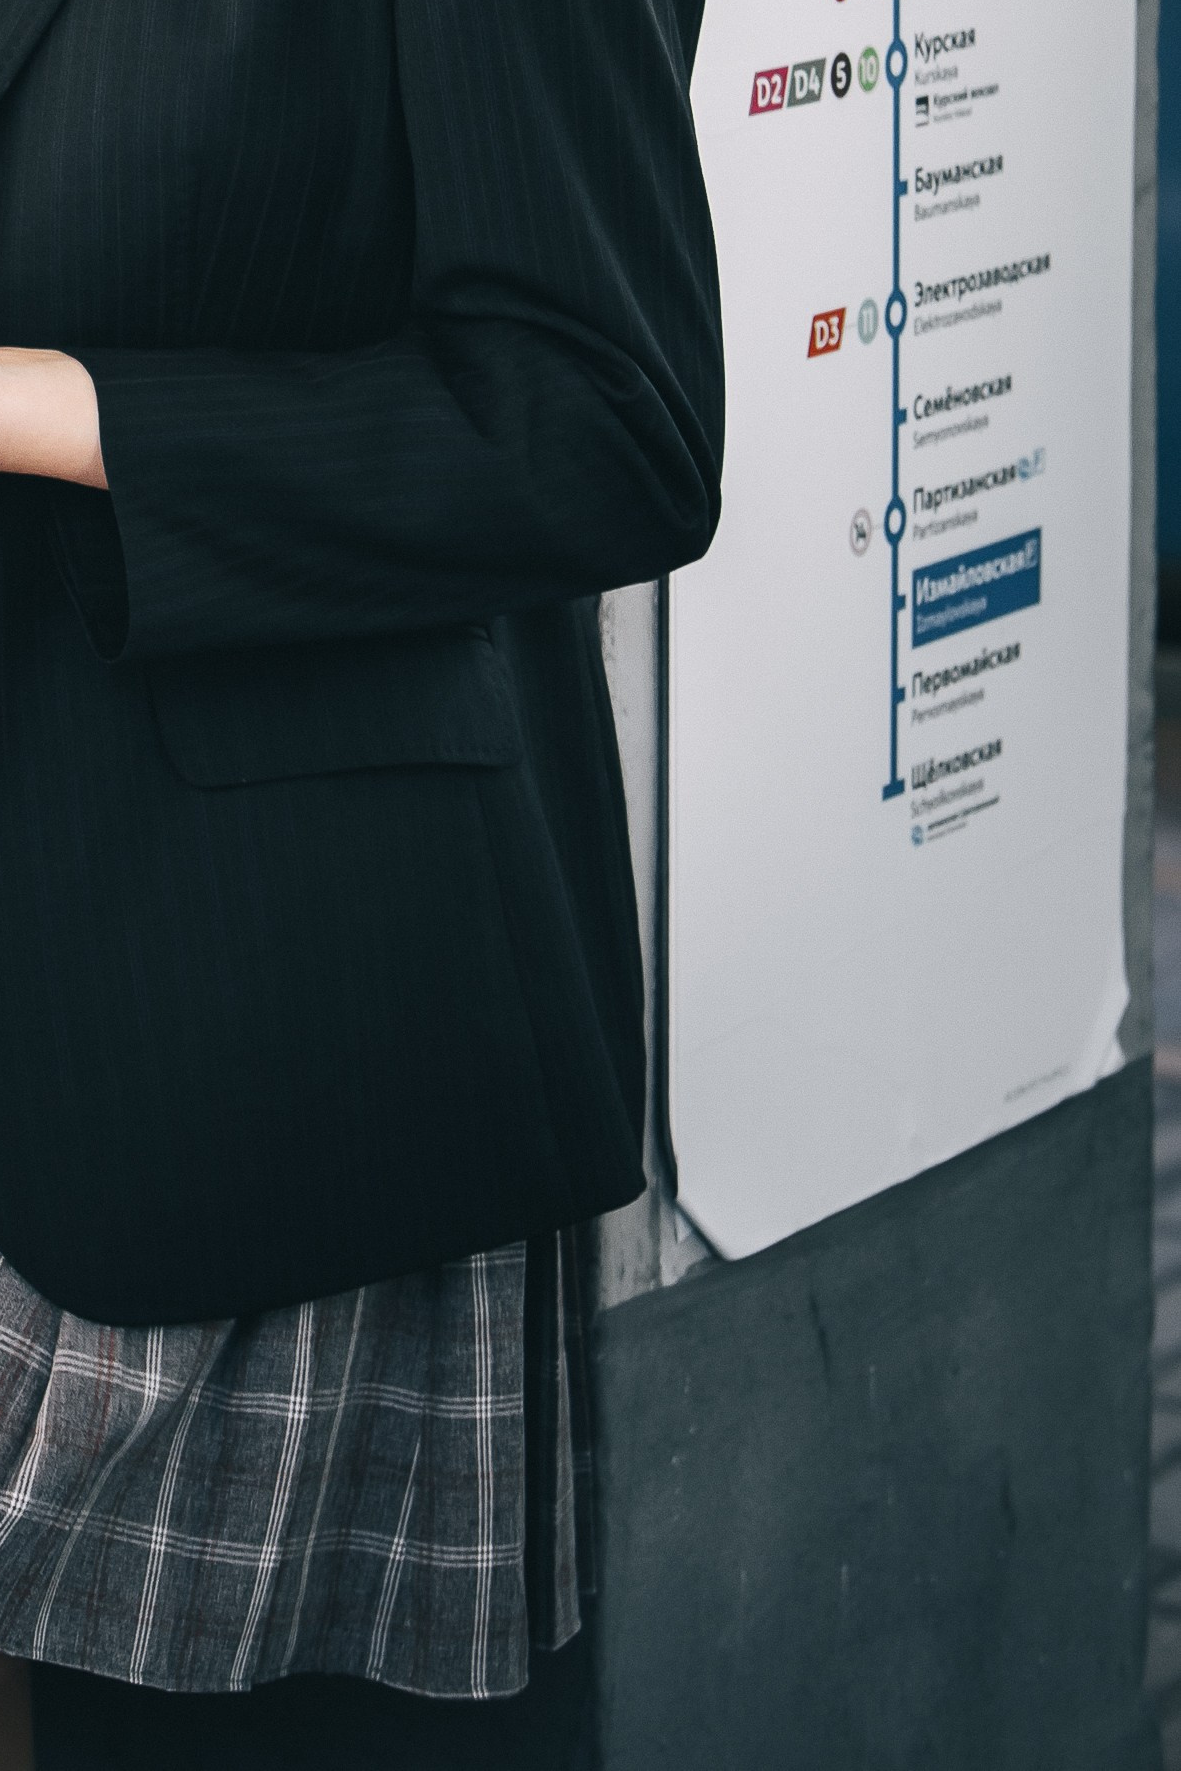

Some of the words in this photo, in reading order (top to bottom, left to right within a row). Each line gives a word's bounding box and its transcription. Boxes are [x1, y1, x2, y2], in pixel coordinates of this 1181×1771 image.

[915, 27, 976, 63] Курская
[756, 73, 783, 108] D2
[794, 65, 821, 100] D4
[835, 60, 847, 90] 5
[915, 154, 1004, 195] Бауманская
[814, 317, 840, 350] D3
[914, 374, 1013, 421] Семёновская
